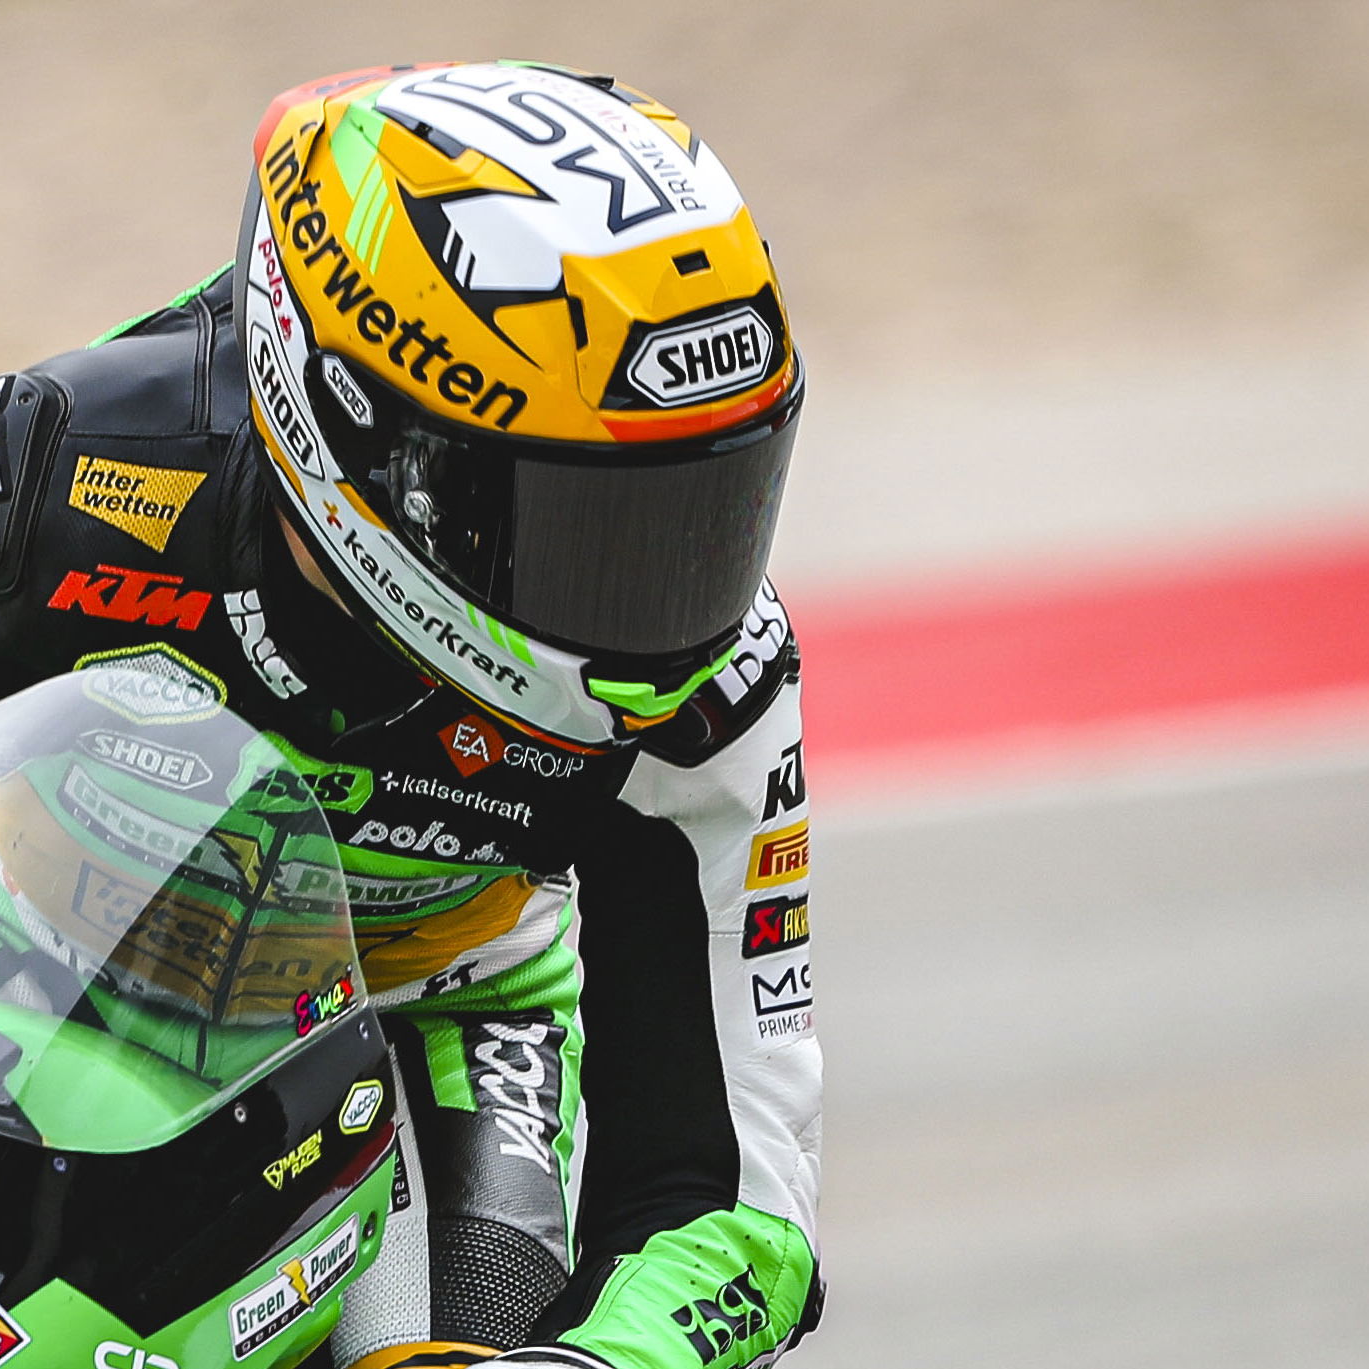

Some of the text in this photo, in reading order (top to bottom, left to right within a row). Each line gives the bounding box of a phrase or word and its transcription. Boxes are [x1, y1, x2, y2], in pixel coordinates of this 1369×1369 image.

[258, 238, 282, 308] polo
[266, 121, 529, 430] interwetten
[656, 322, 762, 391] SHOEI
[253, 340, 316, 464] SHOEI
[328, 364, 368, 420] SHOEI
[79, 457, 145, 493] inter
[83, 488, 176, 522] wetten
[47, 564, 213, 632] KTM
[343, 530, 530, 697] kaiserkraft
[93, 733, 196, 785] SHOEI
[452, 722, 584, 778] EA GROUP
[401, 773, 533, 828] kaiserkraft
[348, 819, 461, 857] polo
[235, 1231, 353, 1335] Green Power
